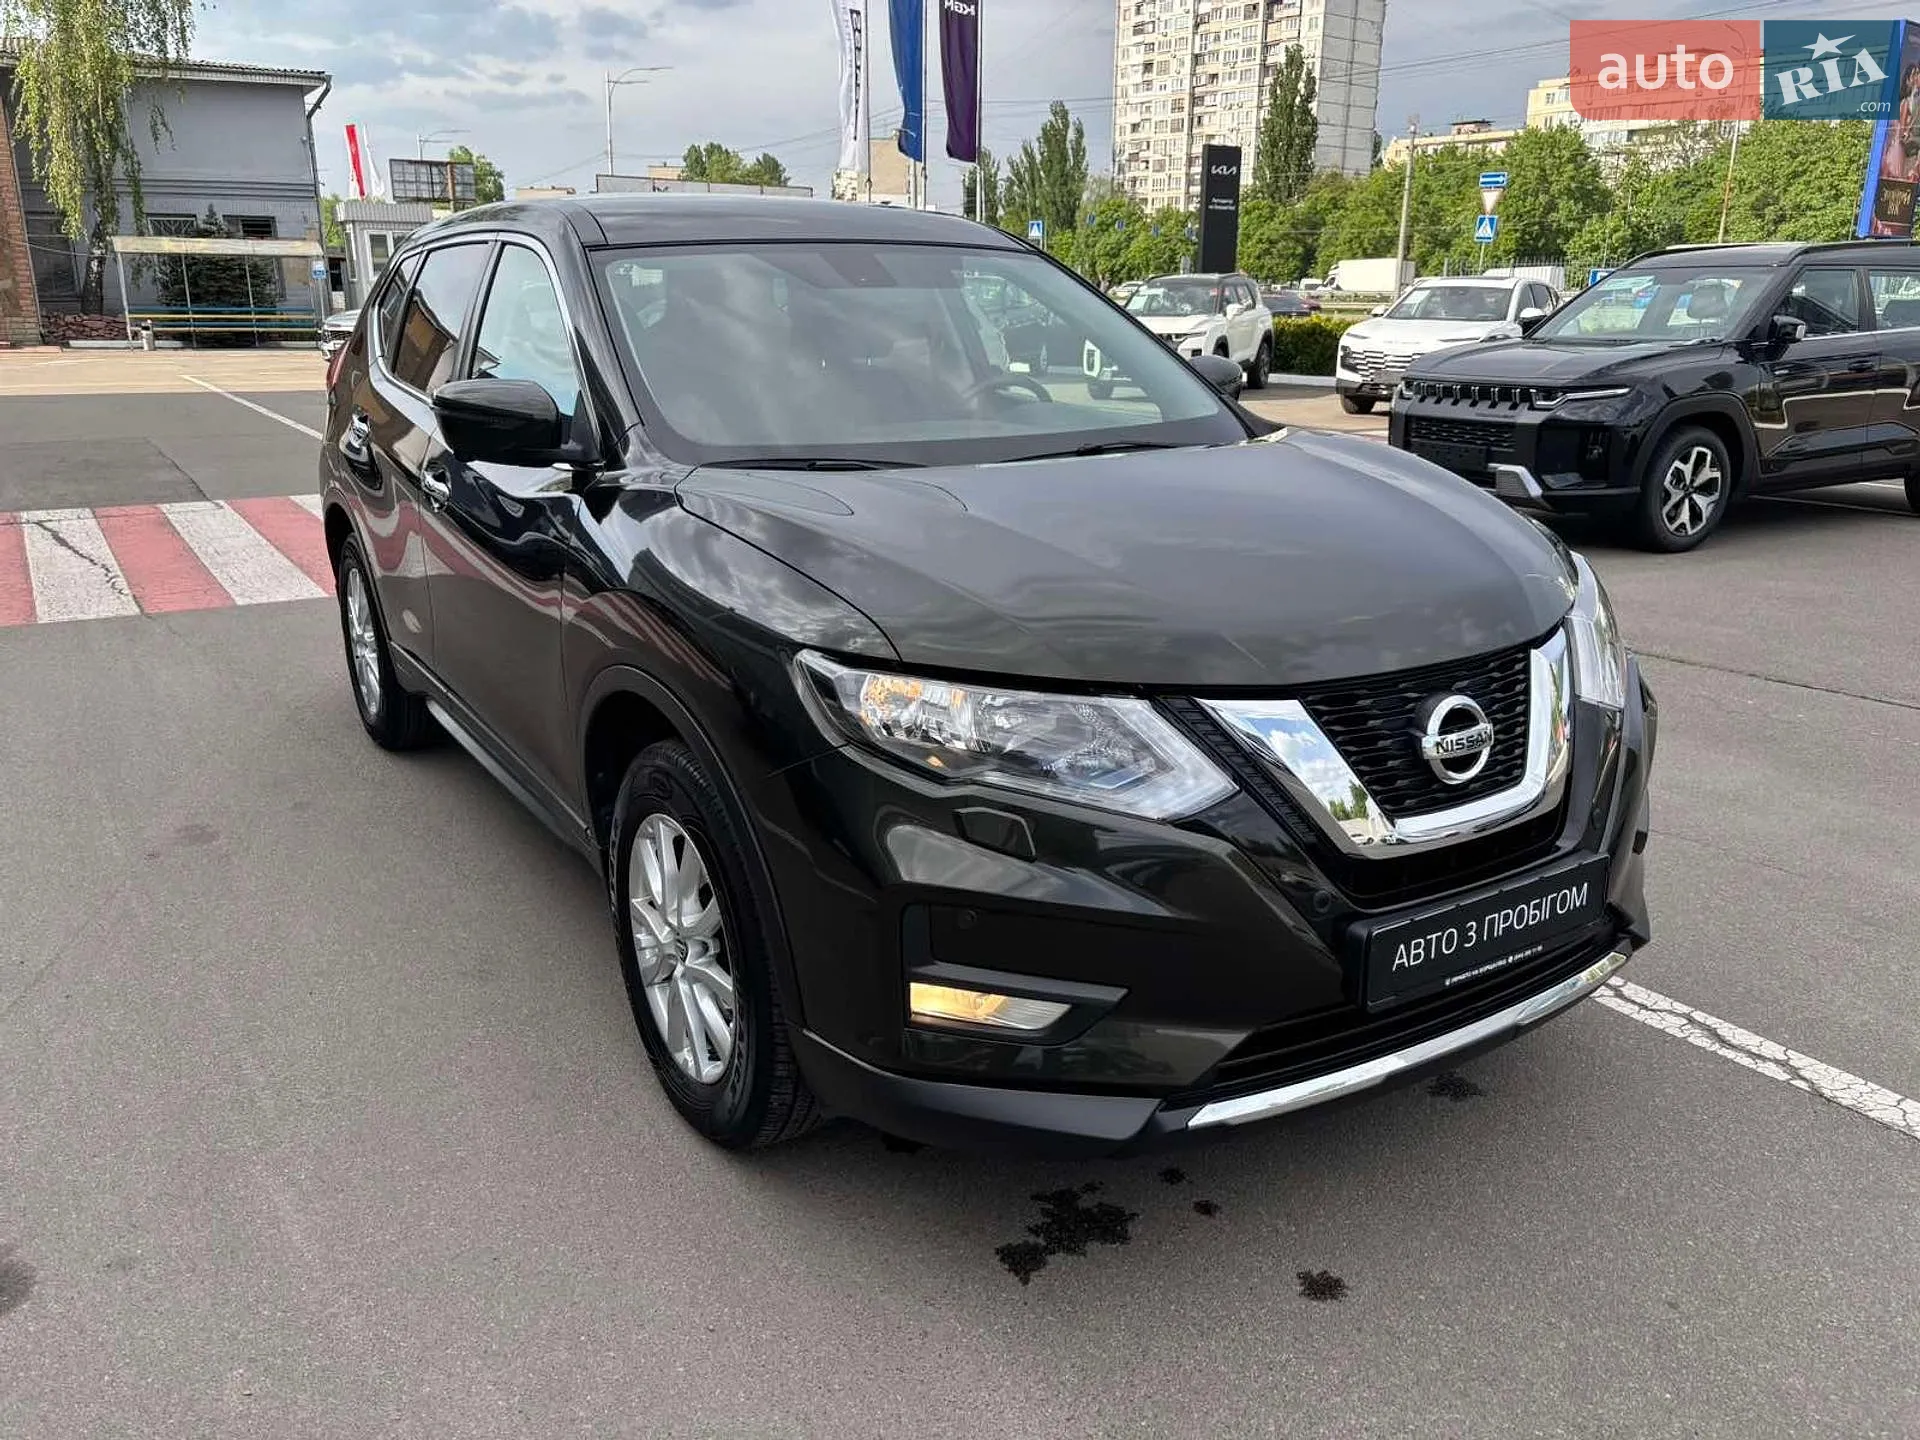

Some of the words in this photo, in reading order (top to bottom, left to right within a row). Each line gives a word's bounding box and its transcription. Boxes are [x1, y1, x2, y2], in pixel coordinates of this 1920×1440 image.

[1211, 165, 1237, 175] KIA
[1436, 729, 1490, 754] NISSAN
[1393, 928, 1458, 971] АВТО
[1483, 882, 1588, 941] ПРОБІГОМ
